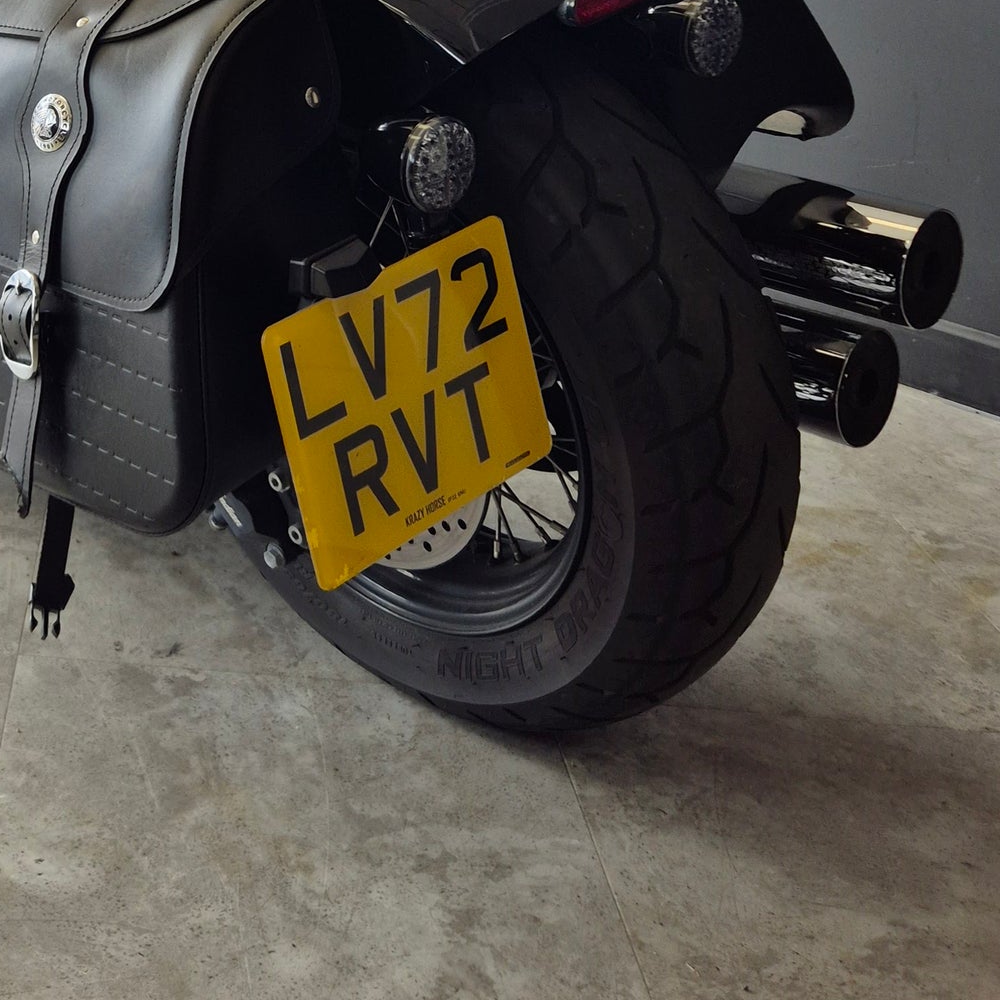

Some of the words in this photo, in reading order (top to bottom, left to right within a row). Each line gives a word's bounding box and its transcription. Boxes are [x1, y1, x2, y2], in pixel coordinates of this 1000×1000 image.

[280, 248, 508, 440] LV72
[333, 361, 490, 537] RVT
[405, 507, 425, 527] KRAZY
[426, 495, 447, 515] HORSE
